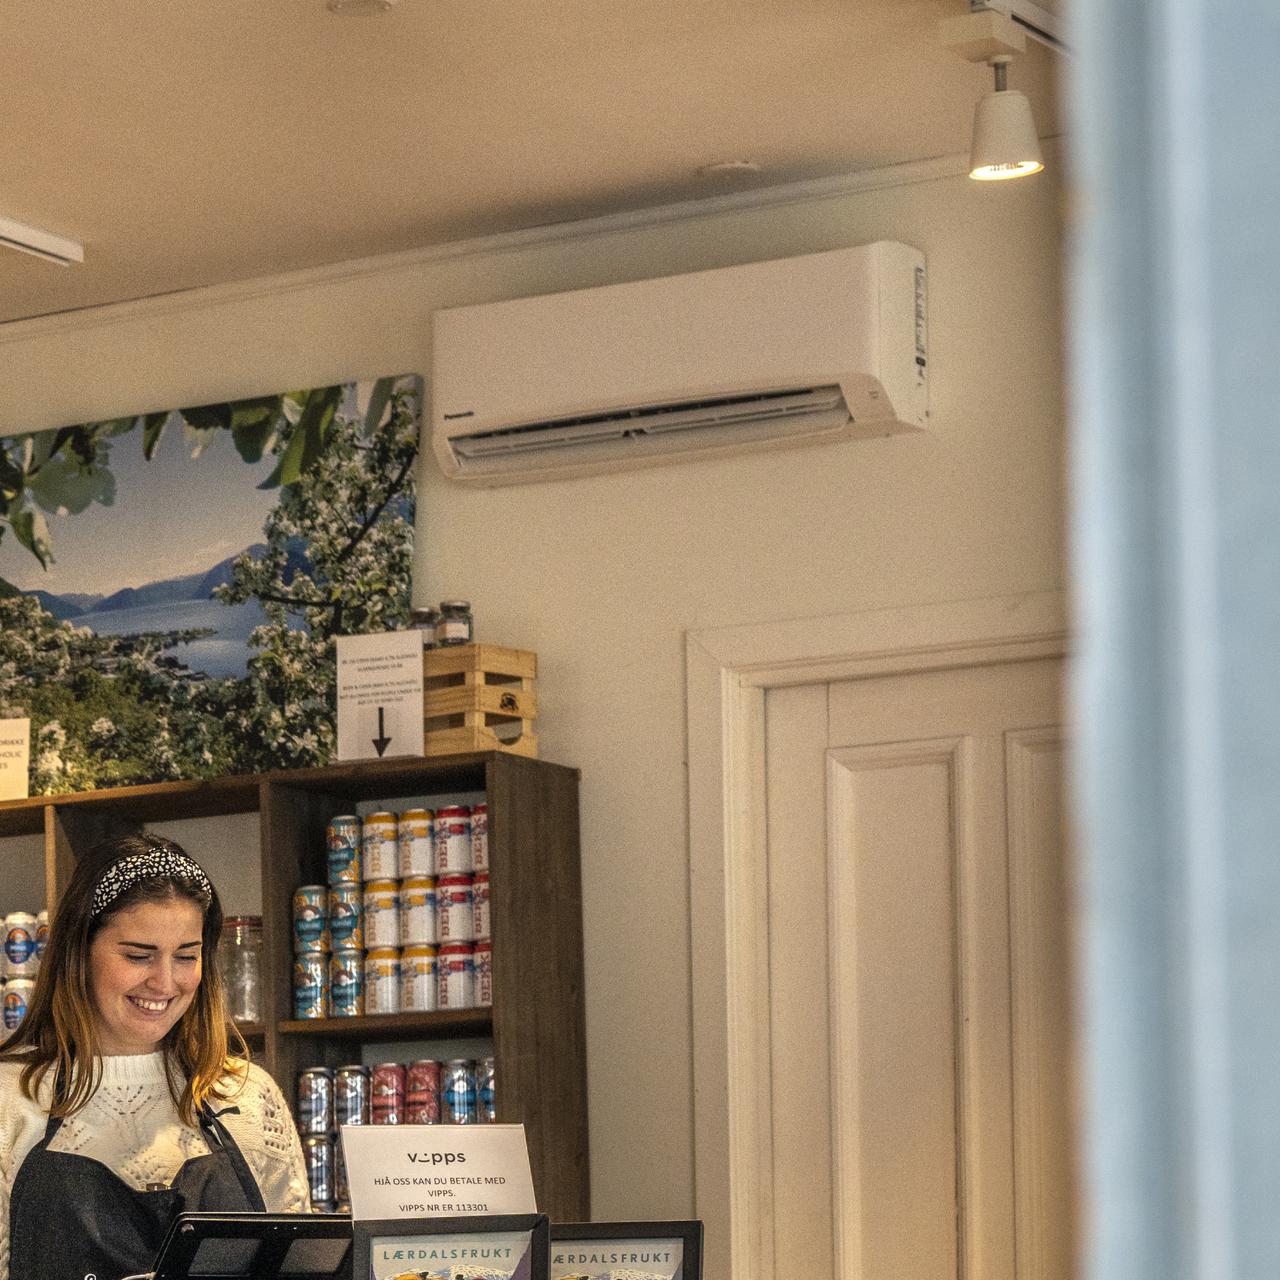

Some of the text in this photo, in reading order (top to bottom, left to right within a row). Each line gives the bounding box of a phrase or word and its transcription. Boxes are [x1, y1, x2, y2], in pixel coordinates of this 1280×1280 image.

[374, 1176, 506, 1186] HJÅ OSS KAN DU BETALE MED
[427, 1189, 457, 1197] VIPPS.
[398, 1203, 488, 1212] VIPPS NR ER 113301
[383, 1248, 512, 1260] LÆRDALSFRUKT
[553, 1253, 671, 1265] ÆRDALSFRUKT
